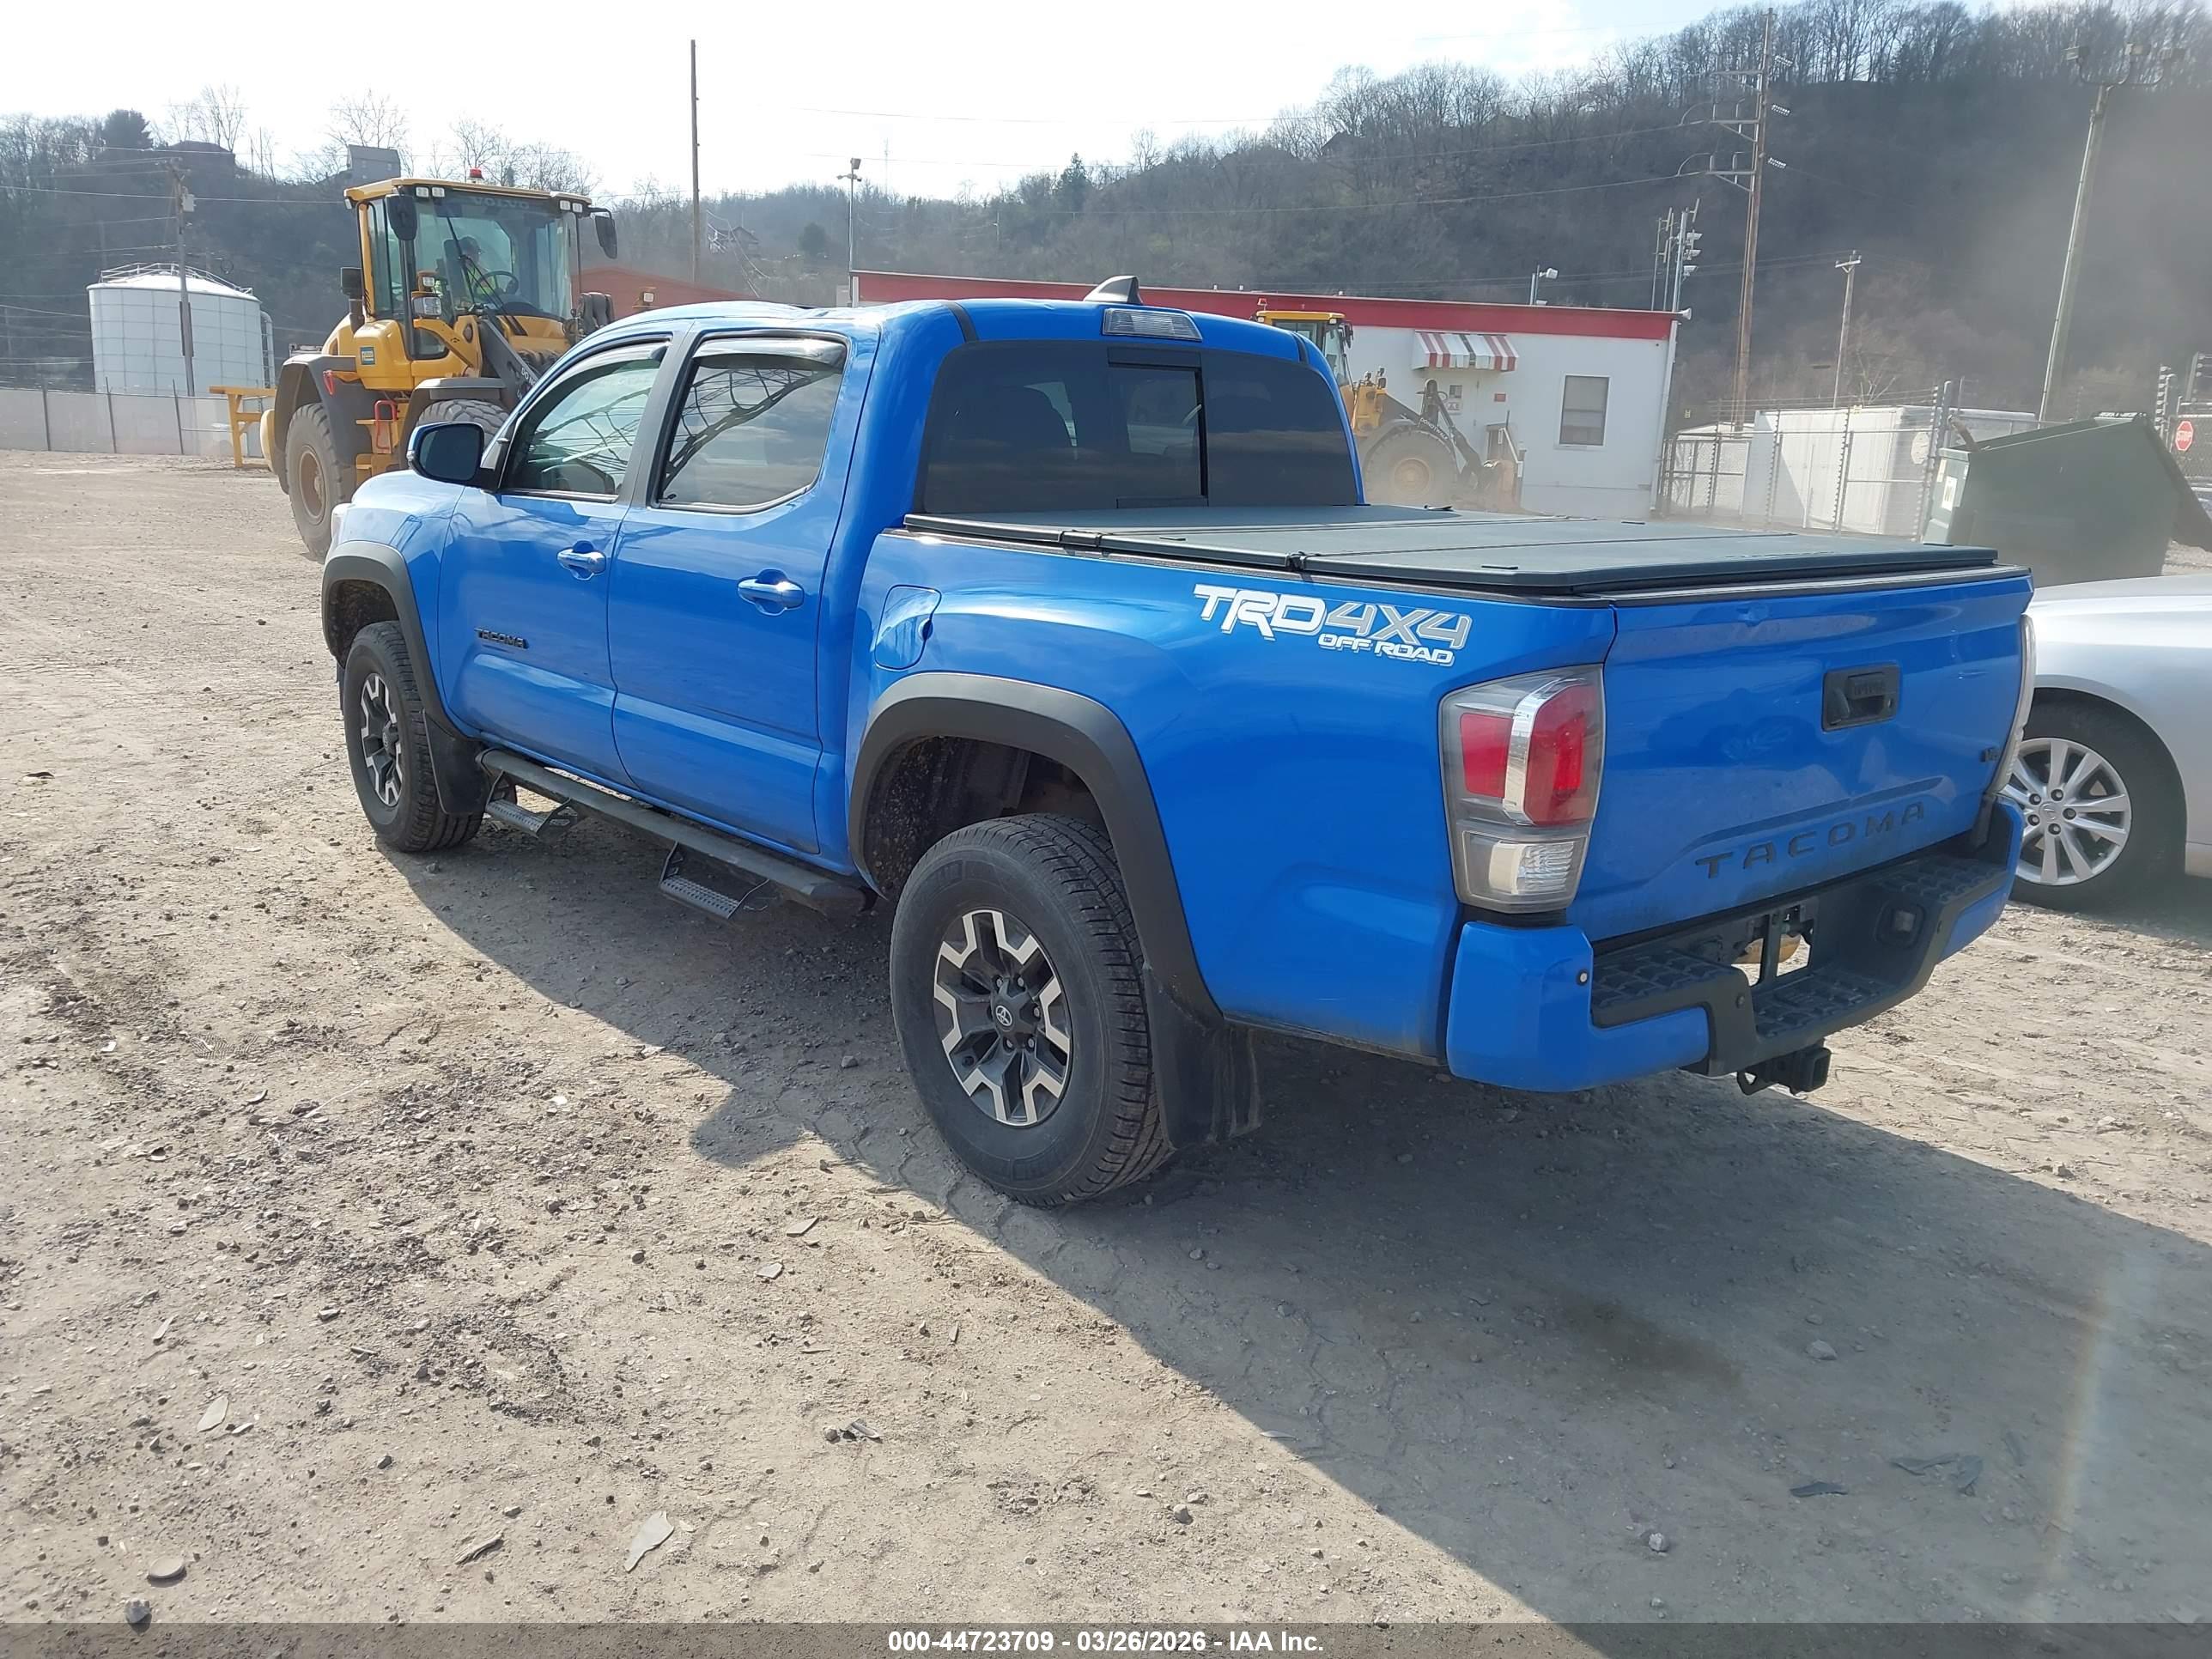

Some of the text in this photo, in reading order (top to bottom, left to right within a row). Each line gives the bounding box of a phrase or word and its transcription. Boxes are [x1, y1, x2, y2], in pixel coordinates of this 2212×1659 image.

[1194, 583, 1328, 641] TRD
[1317, 633, 1456, 667] OFF ROAD
[1695, 800, 1924, 879] TACOMA
